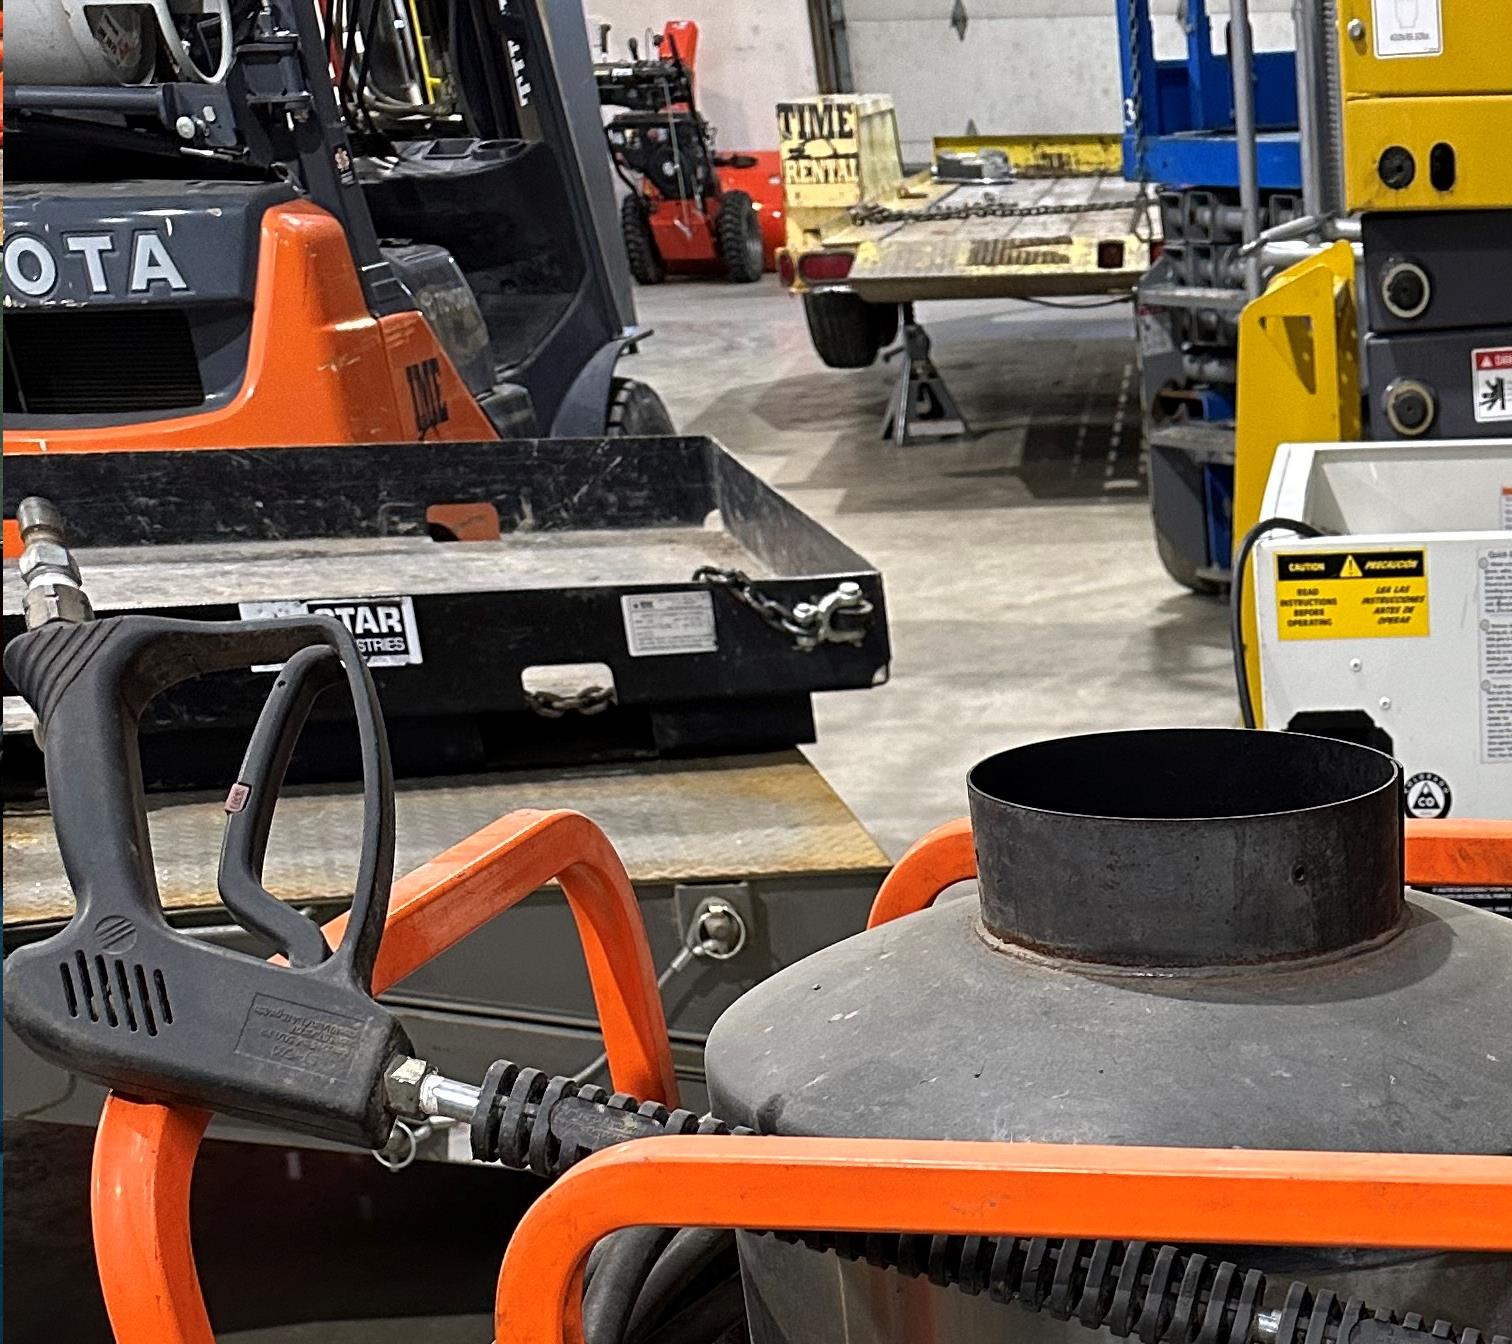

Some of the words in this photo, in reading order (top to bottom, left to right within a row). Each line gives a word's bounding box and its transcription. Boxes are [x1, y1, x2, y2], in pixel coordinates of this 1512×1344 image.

[776, 103, 853, 139] TIME
[785, 160, 859, 184] RENTAL
[1288, 562, 1325, 572] CAUTION
[1297, 588, 1319, 596] READ
[1280, 598, 1337, 607] INSTRUCTIONS
[1294, 608, 1324, 617] BEFORE
[1287, 618, 1332, 627] OPERATING
